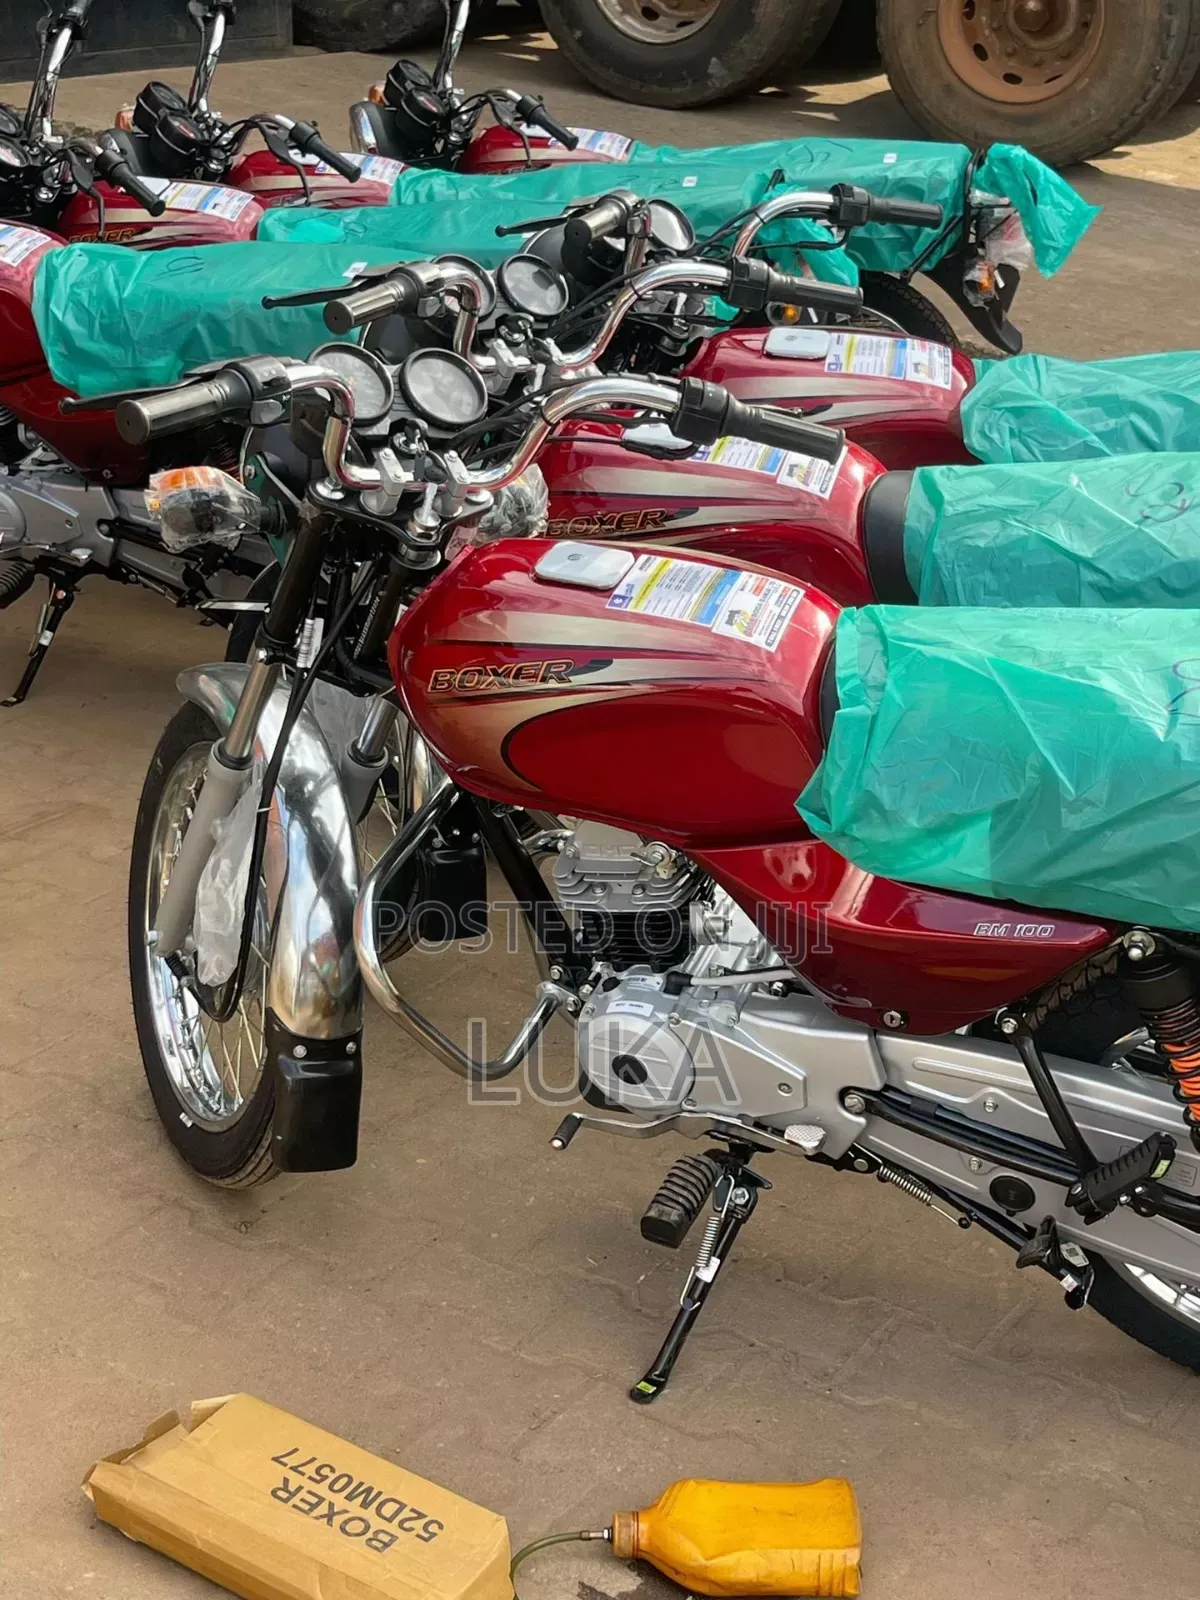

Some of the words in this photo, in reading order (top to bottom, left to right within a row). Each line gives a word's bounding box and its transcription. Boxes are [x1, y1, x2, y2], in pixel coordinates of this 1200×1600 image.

[543, 508, 667, 537] BOXER
[427, 659, 574, 692] BOXER
[973, 923, 1011, 937] BM
[1013, 924, 1056, 938] 100
[270, 1447, 444, 1543] 52DM0577
[270, 1476, 399, 1553] BOXER
